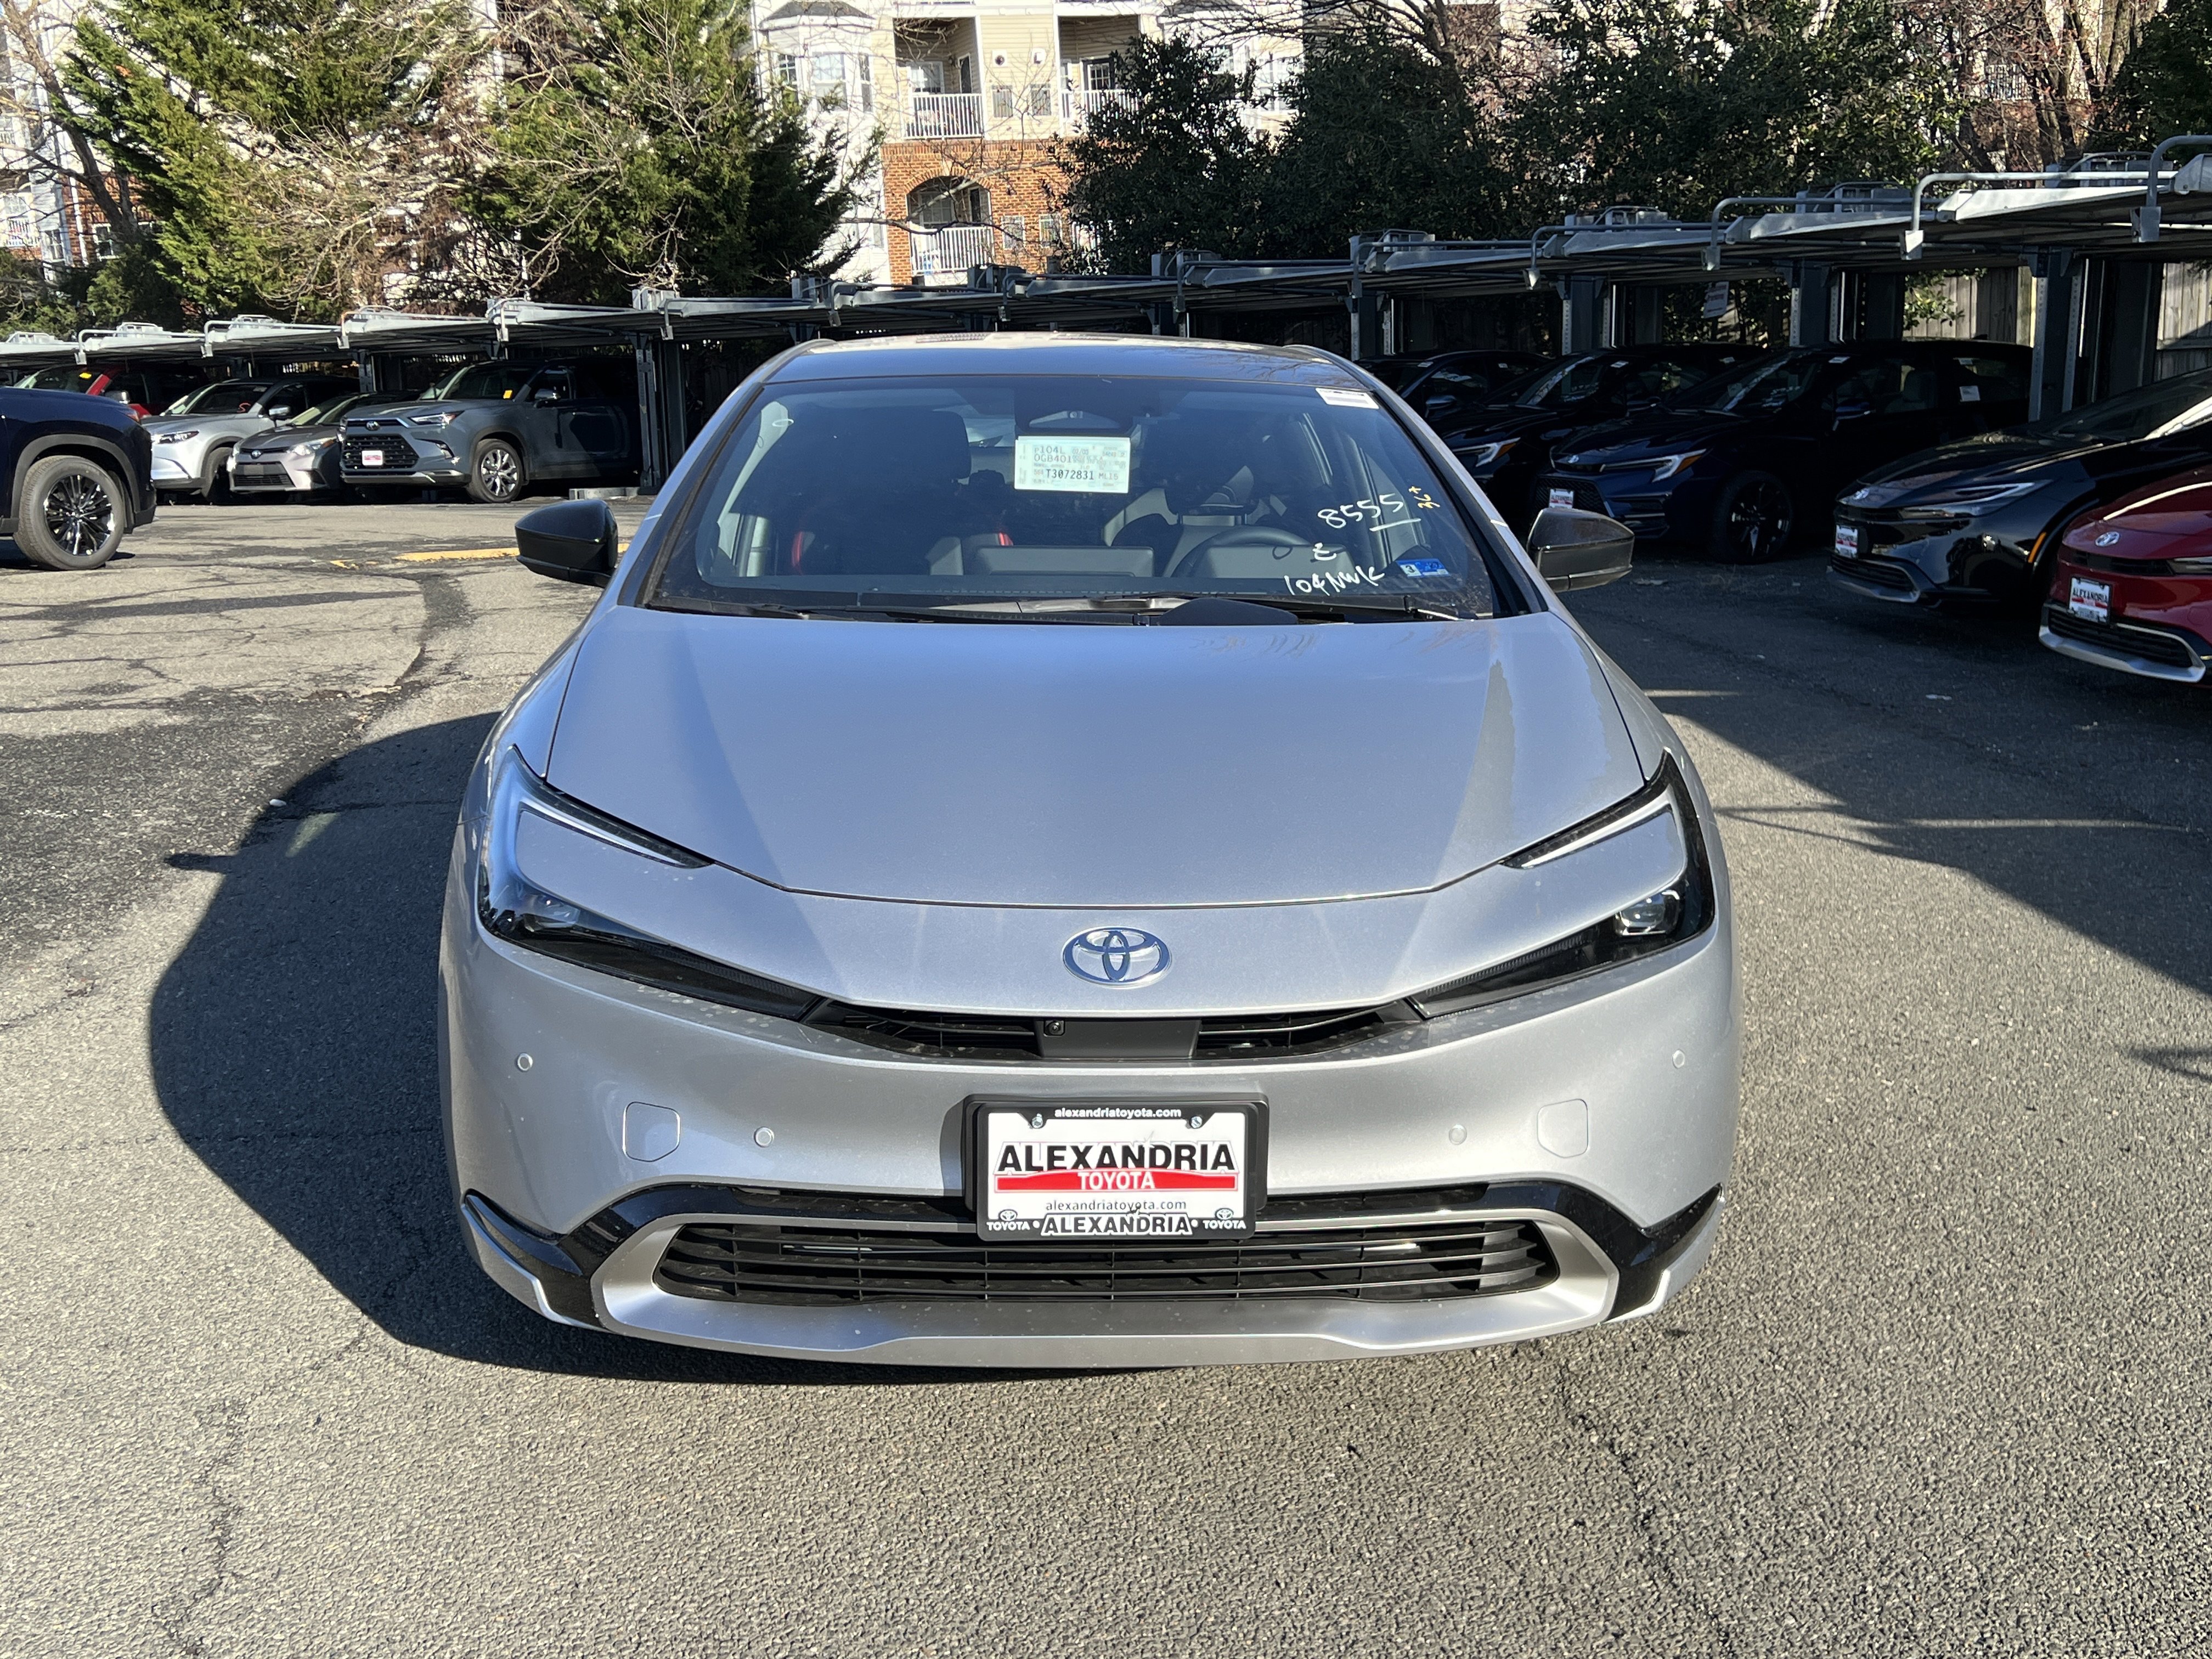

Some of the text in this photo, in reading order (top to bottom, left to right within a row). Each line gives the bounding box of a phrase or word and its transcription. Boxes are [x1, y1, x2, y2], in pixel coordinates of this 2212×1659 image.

[1046, 469, 1094, 481] T3072831
[1317, 493, 1404, 529] 8555
[1054, 1107, 1182, 1119] alexandriatoyota.com
[997, 1144, 1235, 1172] ALEXANDRIA
[1077, 1172, 1156, 1190] TOYOTA
[1046, 1199, 1187, 1211] alexandriatoyota.com
[986, 1216, 1247, 1234] TOYOTA ALEXANDRIA TOYOTA
